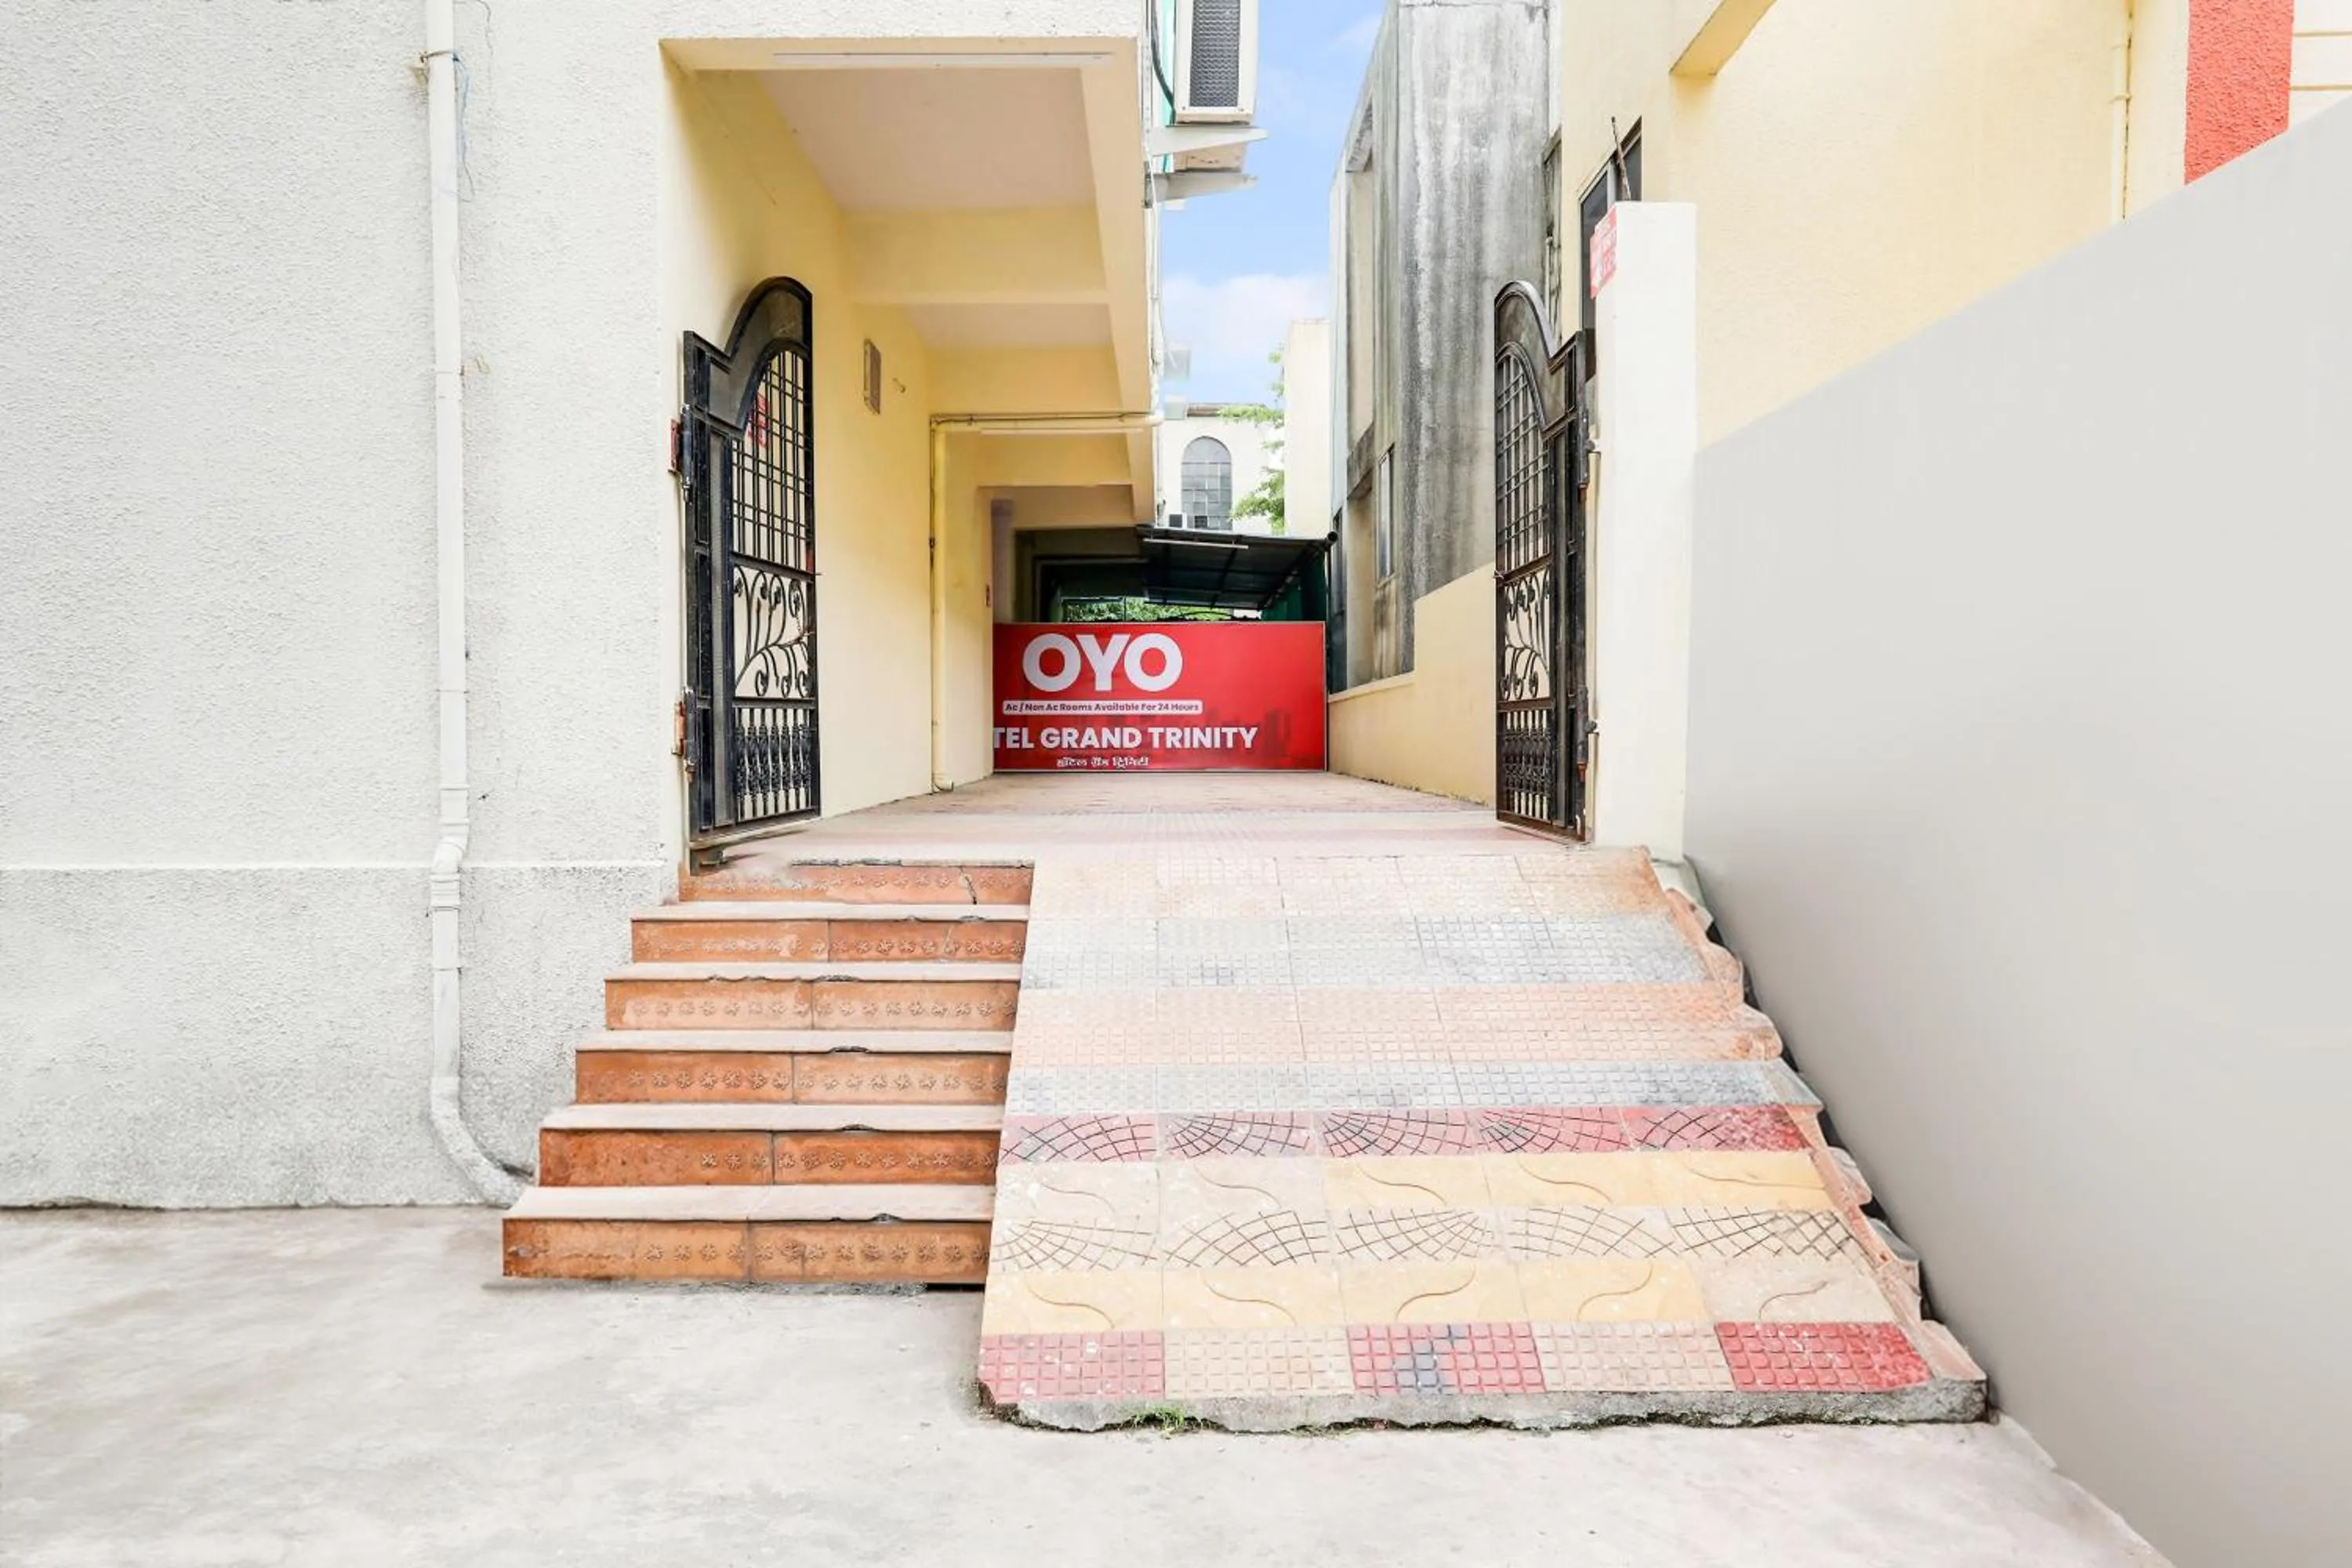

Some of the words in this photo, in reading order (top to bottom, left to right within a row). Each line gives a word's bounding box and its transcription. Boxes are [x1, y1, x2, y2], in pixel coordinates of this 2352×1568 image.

[1022, 633, 1183, 691] OYO
[1046, 702, 1058, 711] Ac
[1059, 702, 1093, 711] Rooms
[1094, 702, 1139, 711] Available
[1141, 702, 1156, 711] For
[1158, 702, 1169, 711] 24
[1171, 702, 1199, 711] Hours
[1040, 726, 1142, 749] GRAND
[1147, 727, 1258, 749] TRINITY
